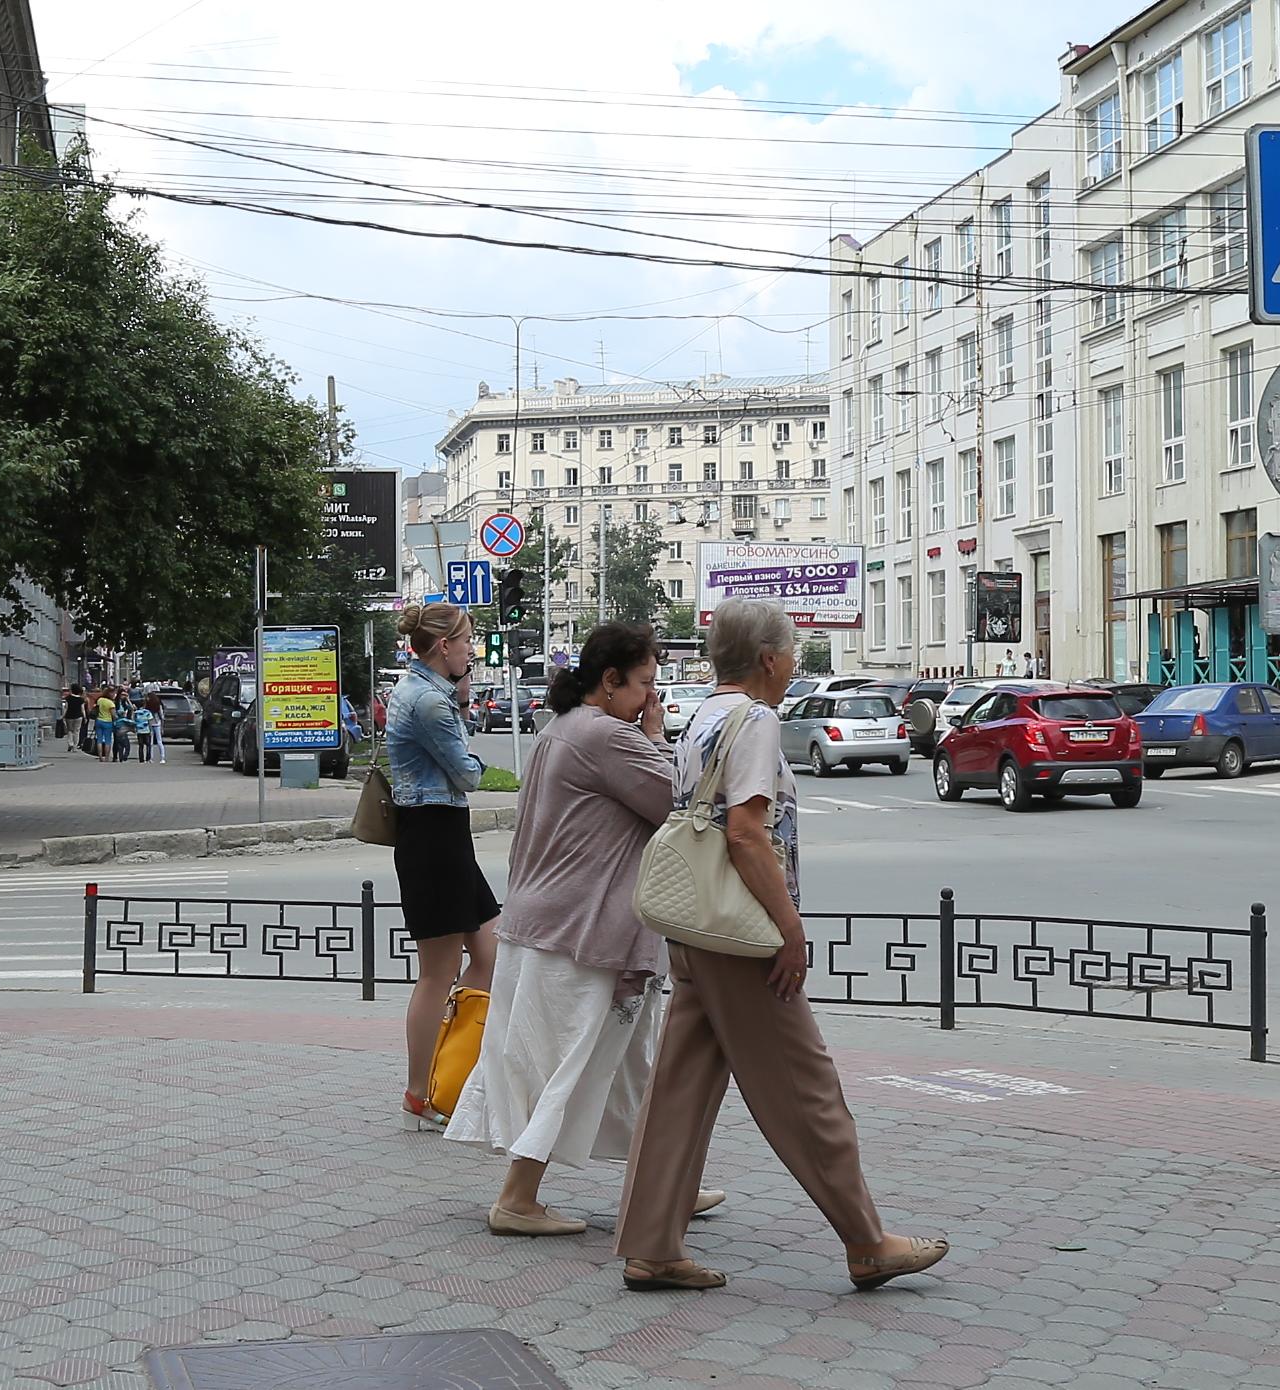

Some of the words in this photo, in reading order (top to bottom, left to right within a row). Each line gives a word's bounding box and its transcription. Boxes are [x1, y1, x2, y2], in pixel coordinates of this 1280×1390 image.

[338, 514, 378, 524] WhatsApp
[726, 546, 840, 560] НОВОМАРУСИНО
[717, 571, 754, 584] Первый
[754, 571, 782, 582] взнос
[786, 566, 803, 579] 75
[805, 564, 839, 578] 000
[731, 584, 770, 595] Ипотека
[773, 585, 782, 596] 3
[785, 582, 810, 595] 634
[801, 598, 858, 607] 204-00-00
[265, 682, 313, 694] Горящие
